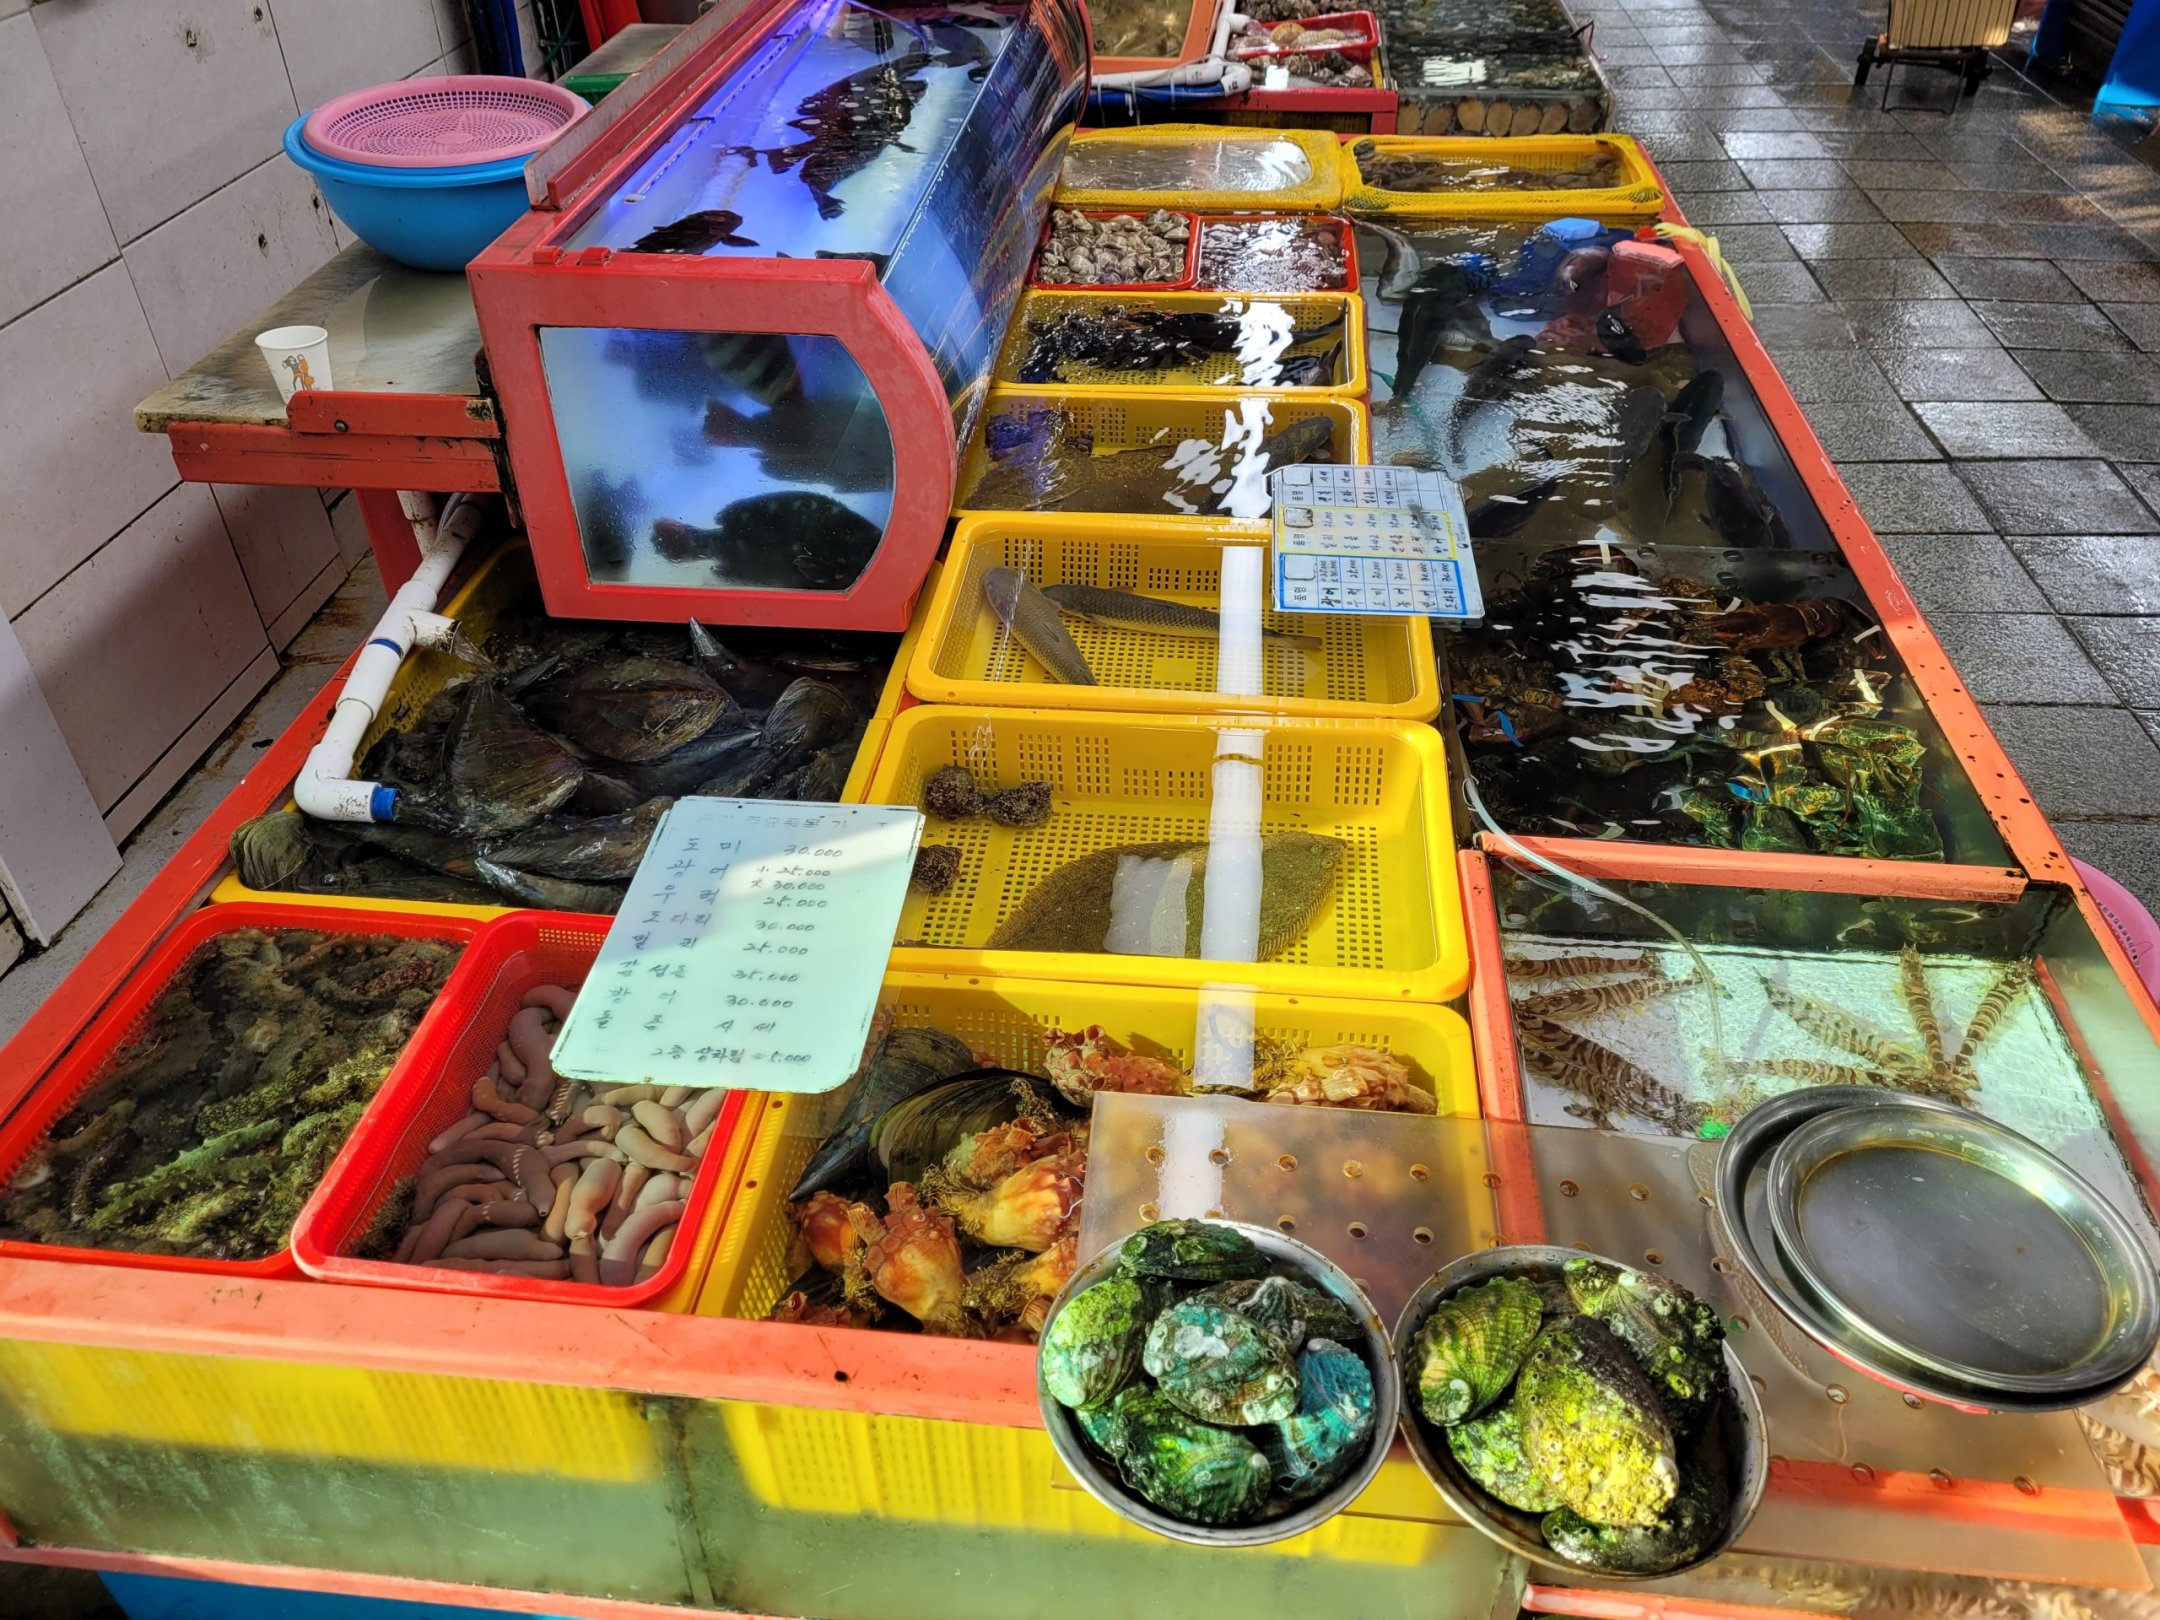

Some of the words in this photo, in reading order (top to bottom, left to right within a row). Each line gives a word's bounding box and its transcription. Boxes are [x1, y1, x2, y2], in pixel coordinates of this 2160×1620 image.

[783, 845, 843, 857] 30.000
[773, 881, 825, 890] 30.000
[763, 895, 827, 908] 25.000
[755, 920, 814, 931] 30.000
[743, 941, 808, 954] 25.000
[725, 995, 793, 1008] 30.000
